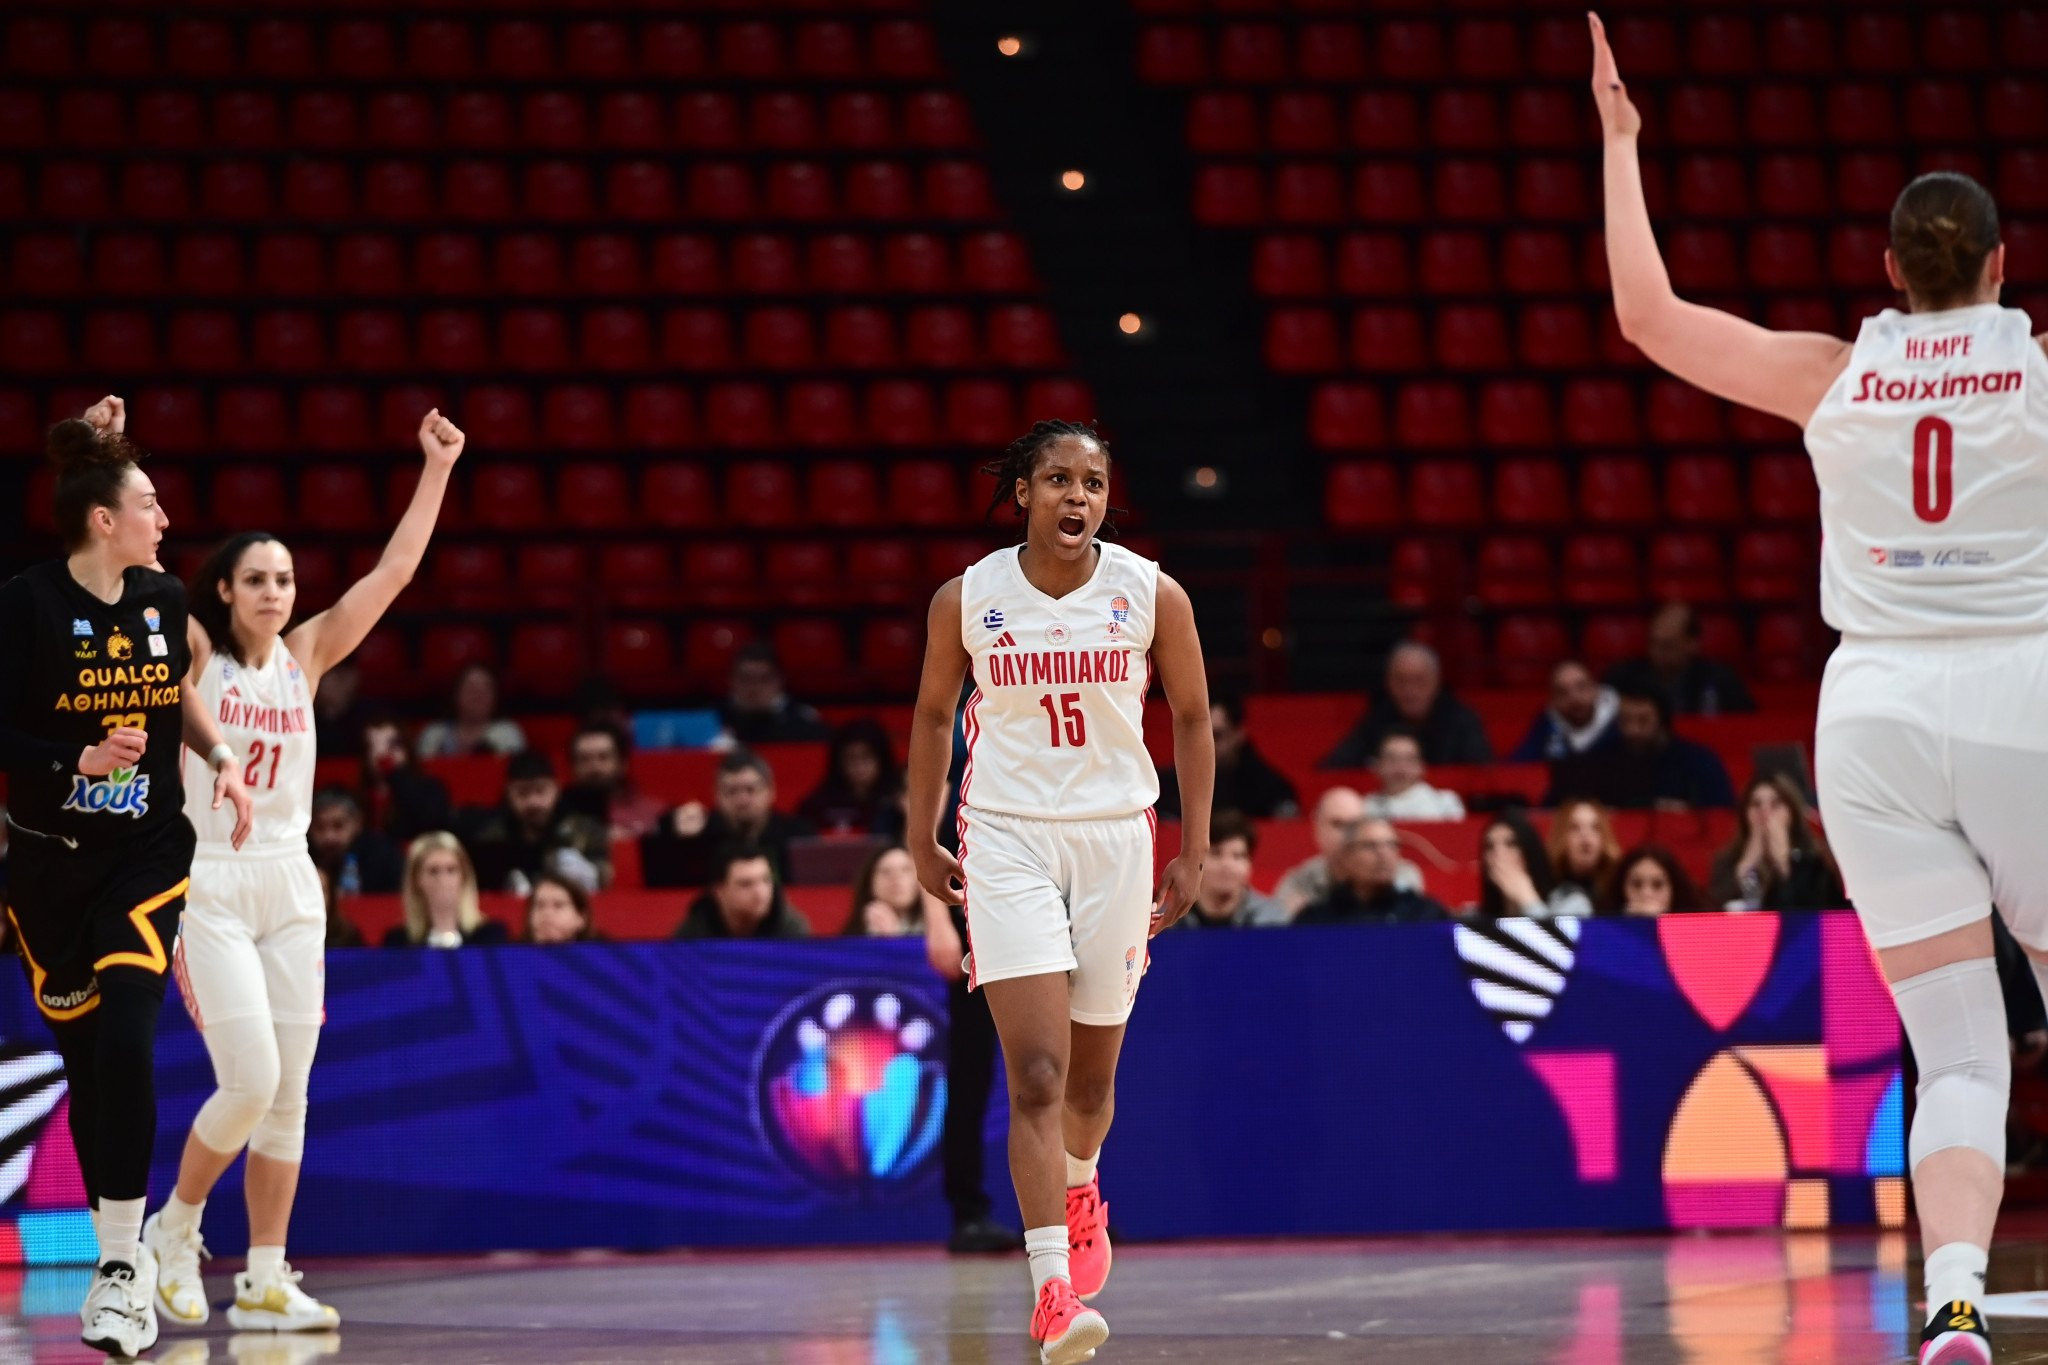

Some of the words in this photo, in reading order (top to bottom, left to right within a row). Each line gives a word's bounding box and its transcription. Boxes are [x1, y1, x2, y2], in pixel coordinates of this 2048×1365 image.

[1906, 334, 1973, 360] HEMPE
[1852, 370, 2023, 402] Stoiximan
[1913, 414, 1953, 524] 0
[78, 662, 170, 688] QUALCO
[989, 649, 1131, 687] ΟΛΥΜΠΙΑΚΟΣ
[55, 685, 180, 712] ΑΘΗΝΑΪΚΟΣ
[1039, 692, 1086, 748] 15
[244, 739, 283, 790] 21
